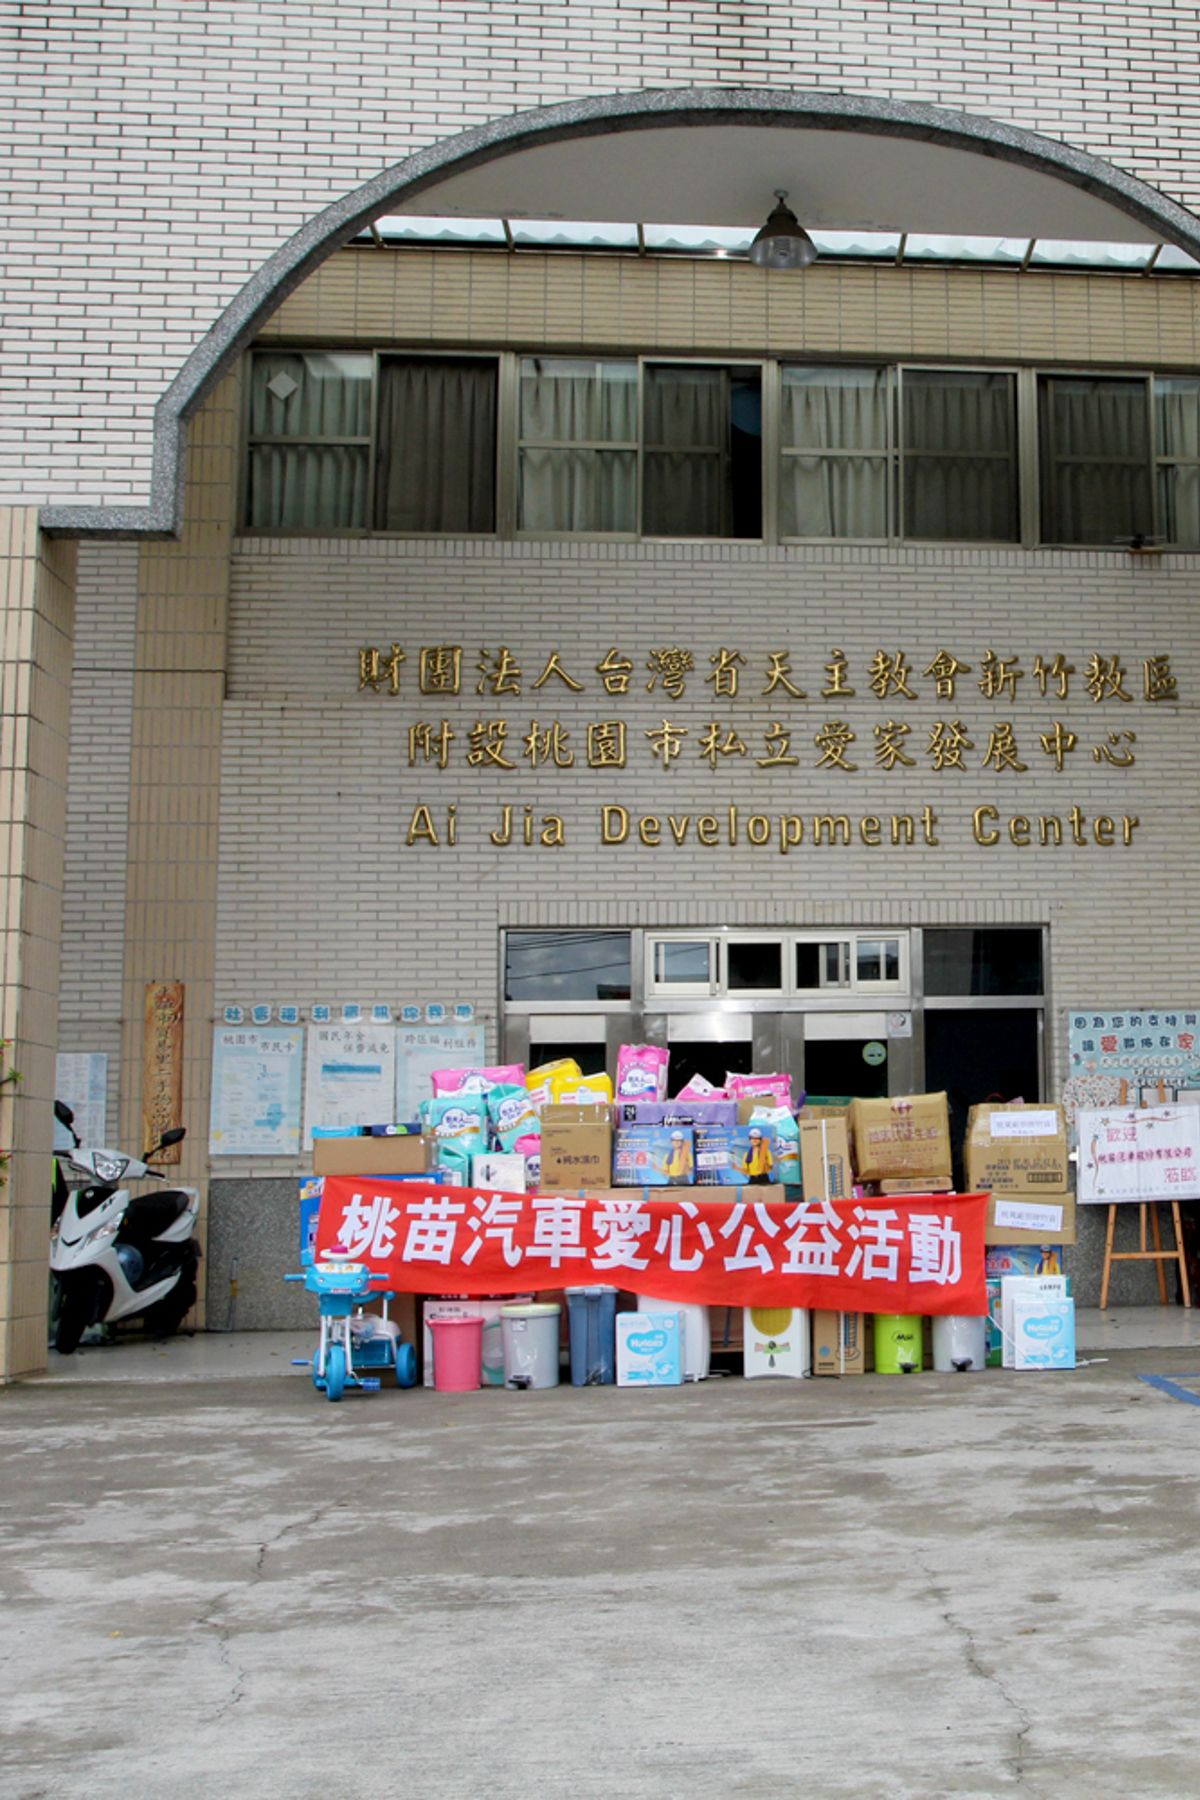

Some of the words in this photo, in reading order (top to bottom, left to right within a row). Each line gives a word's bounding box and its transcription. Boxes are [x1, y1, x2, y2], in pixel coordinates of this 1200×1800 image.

[356, 645, 1181, 702] 財團法人台灣省天主教會新竹教區
[407, 719, 1138, 774] 附設桃園市私立愛家發展中心
[404, 804, 458, 847] Ai
[488, 804, 567, 847] Jia
[600, 804, 939, 854] Development
[972, 804, 1141, 847] Center
[1106, 1126, 1138, 1143] 歡迎
[334, 1193, 963, 1285] 桃苗汽車愛心公益活動
